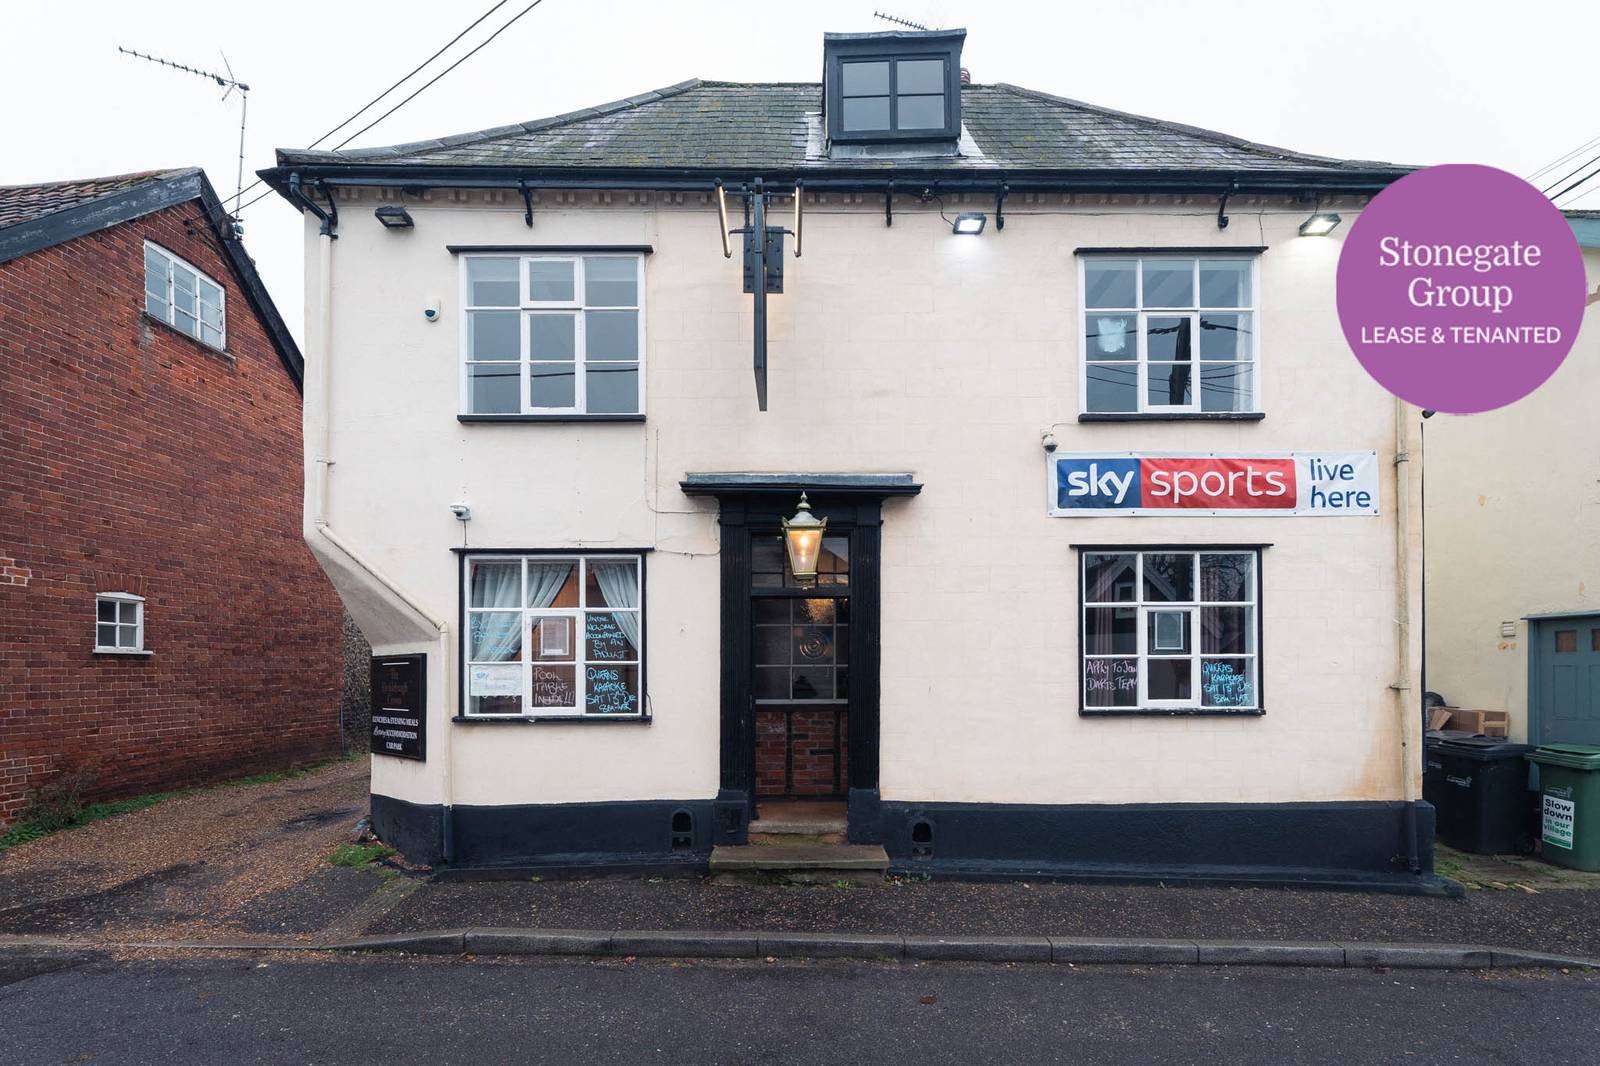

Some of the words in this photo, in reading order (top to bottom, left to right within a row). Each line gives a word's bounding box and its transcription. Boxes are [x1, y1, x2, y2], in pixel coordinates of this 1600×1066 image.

[1310, 458, 1354, 482] live
[1067, 463, 1135, 504] sky
[1150, 465, 1288, 504] sports
[1310, 485, 1371, 508] here
[1545, 799, 1572, 812] Slow
[1543, 808, 1573, 822] down
[1543, 823, 1573, 837] village
[1545, 816, 1553, 825] in
[1554, 821, 1570, 830] our
